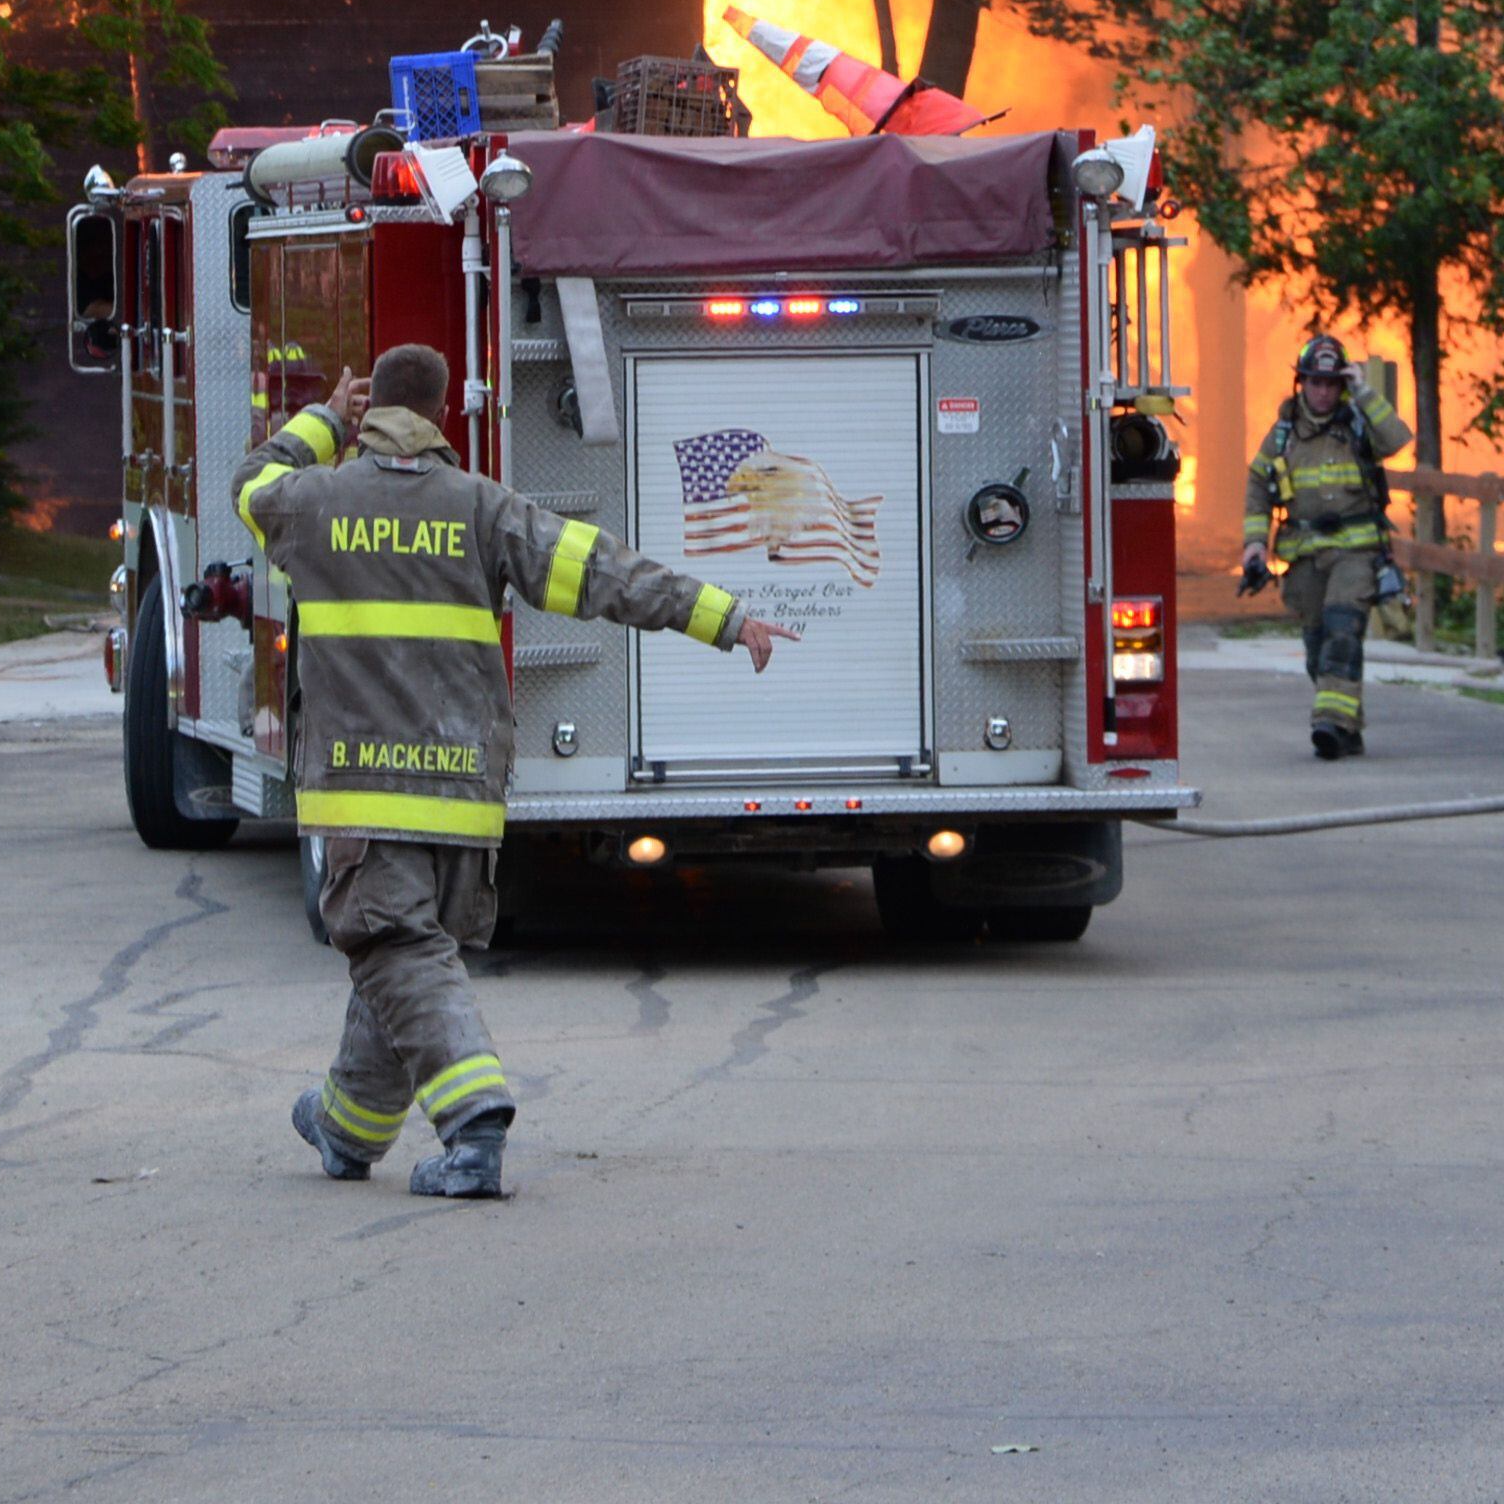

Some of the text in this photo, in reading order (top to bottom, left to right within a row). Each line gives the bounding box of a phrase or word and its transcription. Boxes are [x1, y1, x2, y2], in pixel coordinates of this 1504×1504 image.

[330, 516, 467, 558] NAPLATE
[759, 582, 817, 600] Forget
[821, 581, 853, 598] Our
[773, 602, 842, 618] Brothers
[332, 740, 480, 773] B. MACKENZIE
